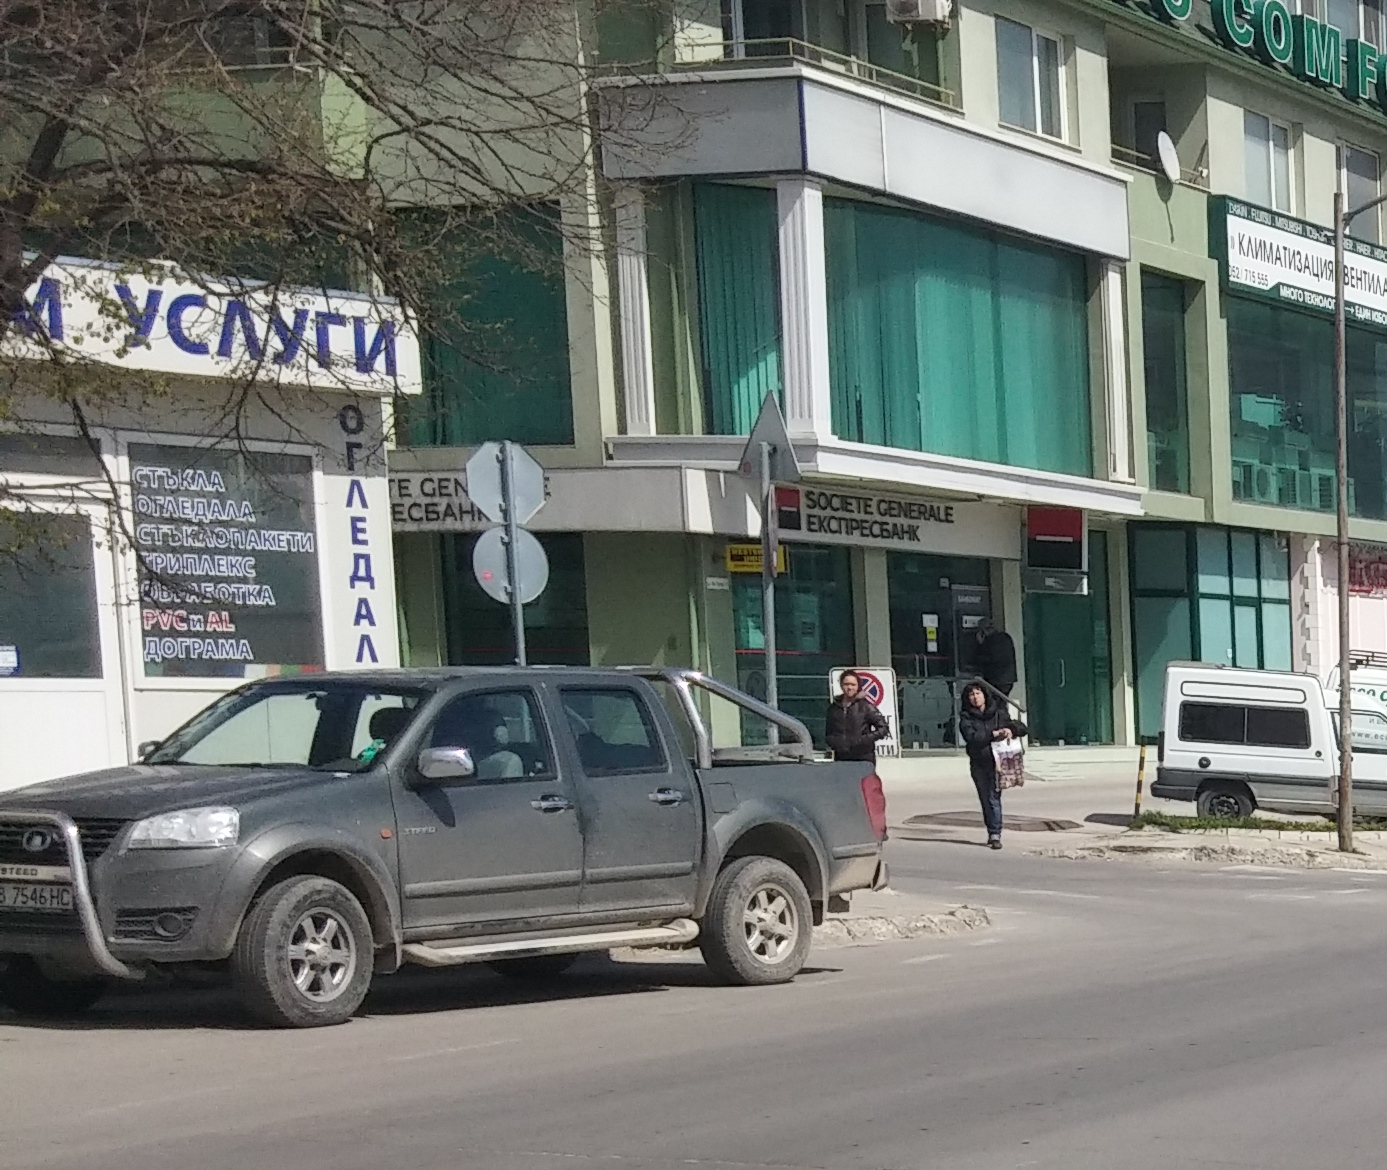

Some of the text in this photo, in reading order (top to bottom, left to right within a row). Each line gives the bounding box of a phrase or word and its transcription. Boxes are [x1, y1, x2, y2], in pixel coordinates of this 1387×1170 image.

[1238, 232, 1334, 283] КЛИМАТИЗАЦИЯ
[1279, 285, 1303, 302] МНОГО
[114, 282, 398, 377] УСЛУГИ
[132, 466, 225, 492] СТЪКЛА
[134, 495, 256, 523] ОГЛЕДАЛА
[805, 490, 955, 524] SOCIETE GENERALE
[137, 524, 314, 552] СТЪКЛОПАКЕТИ
[806, 514, 921, 543] ЕКСПРЕСБАНК
[140, 552, 256, 577] ТРИПЛЕКС
[140, 582, 276, 606] ОБРАБОТКА
[142, 609, 188, 632] PVC
[206, 611, 236, 632] AL
[143, 637, 254, 661] ДОГРАМА
[0, 867, 38, 877] STEED
